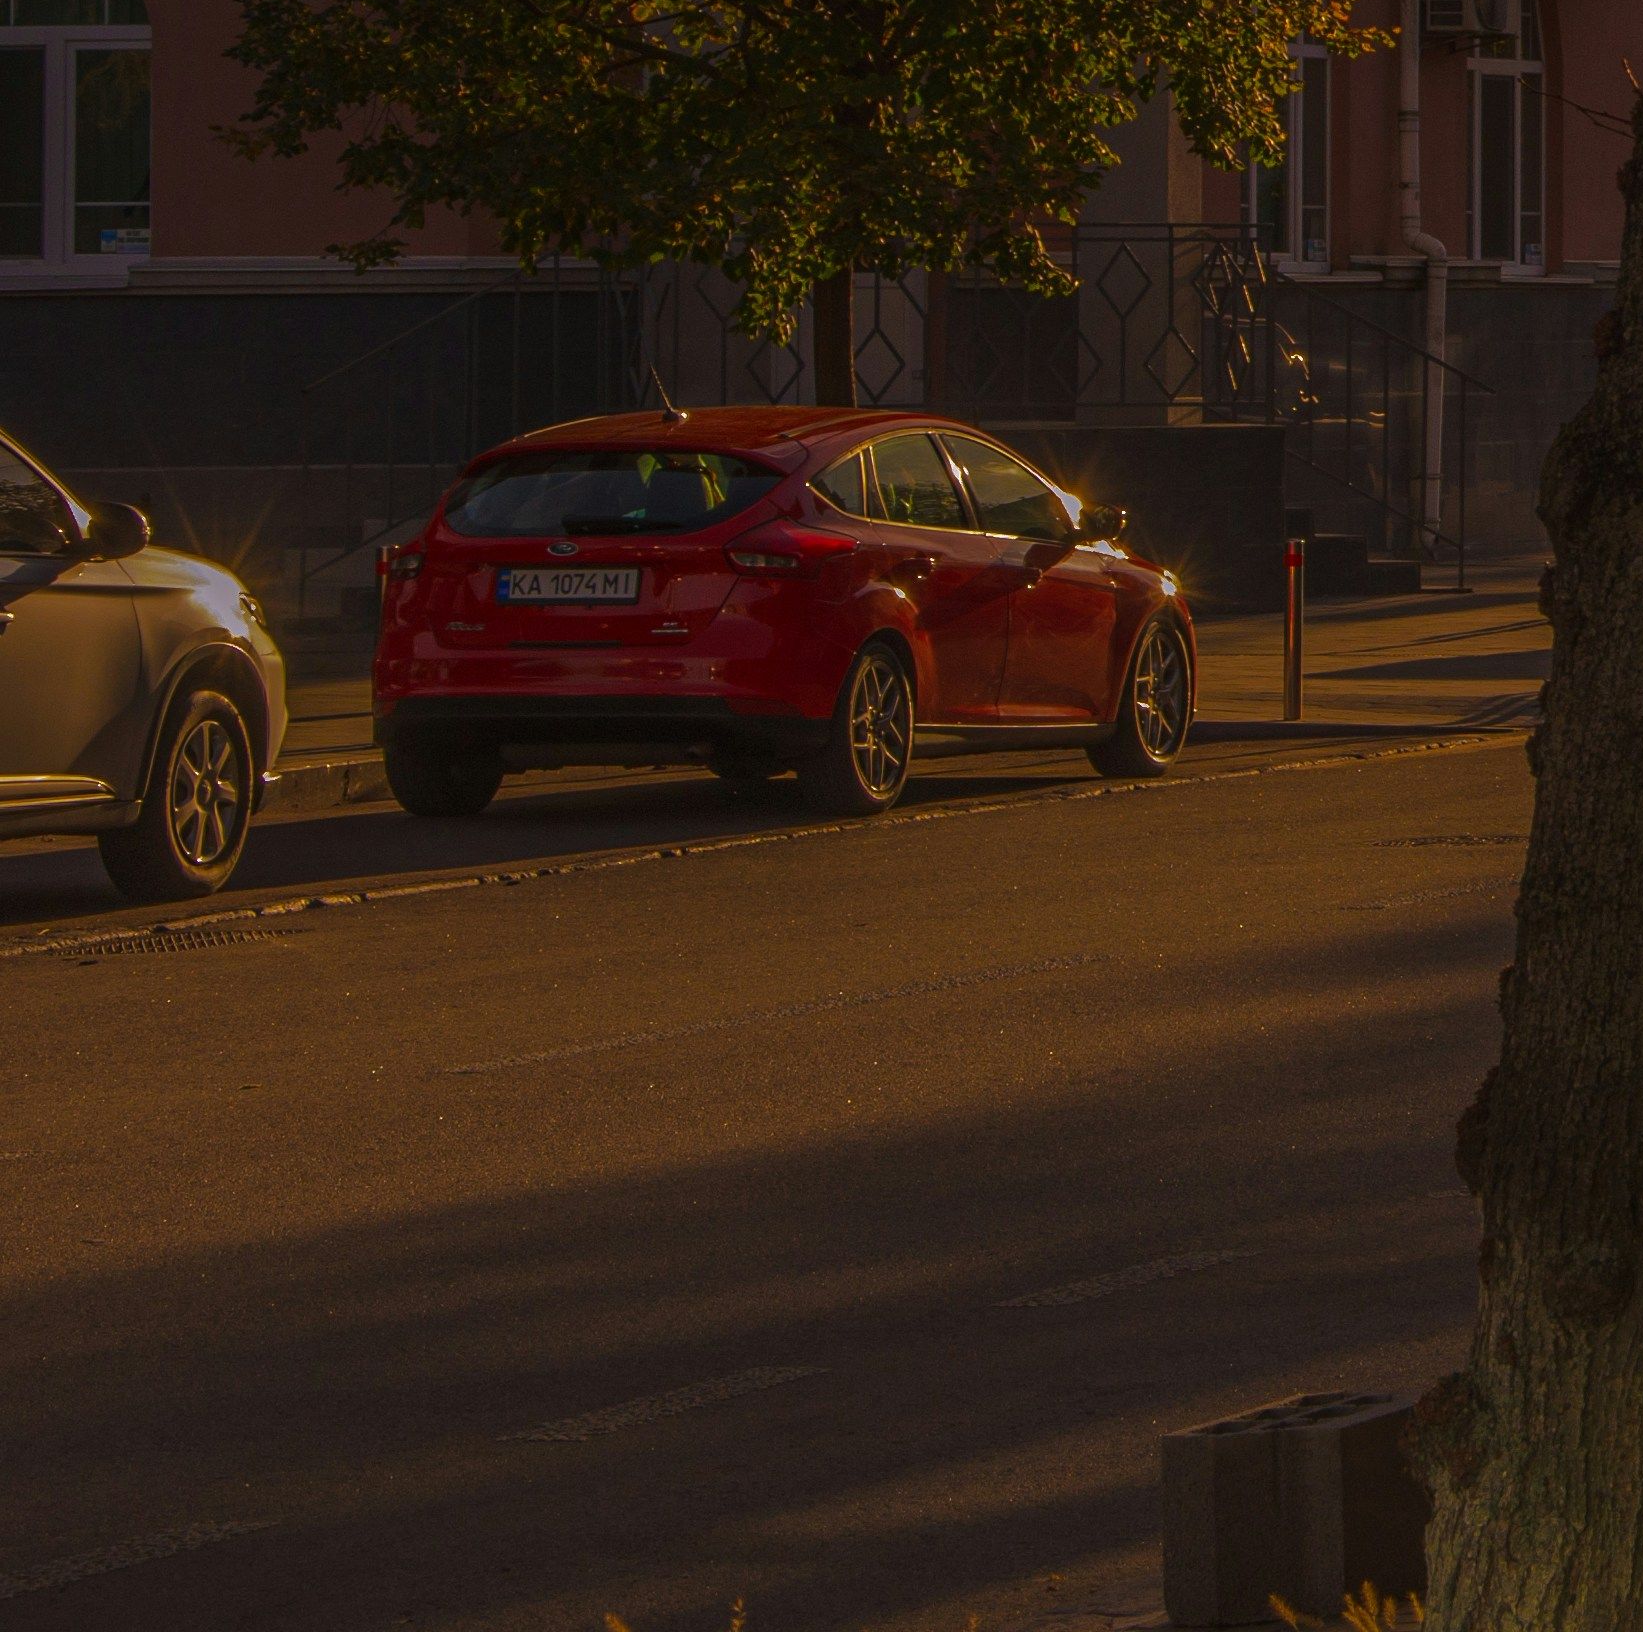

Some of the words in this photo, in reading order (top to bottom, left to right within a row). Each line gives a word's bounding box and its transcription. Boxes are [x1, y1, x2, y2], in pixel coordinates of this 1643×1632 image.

[511, 574, 541, 595] KA
[550, 573, 597, 595] 1074
[602, 574, 629, 595] MI
